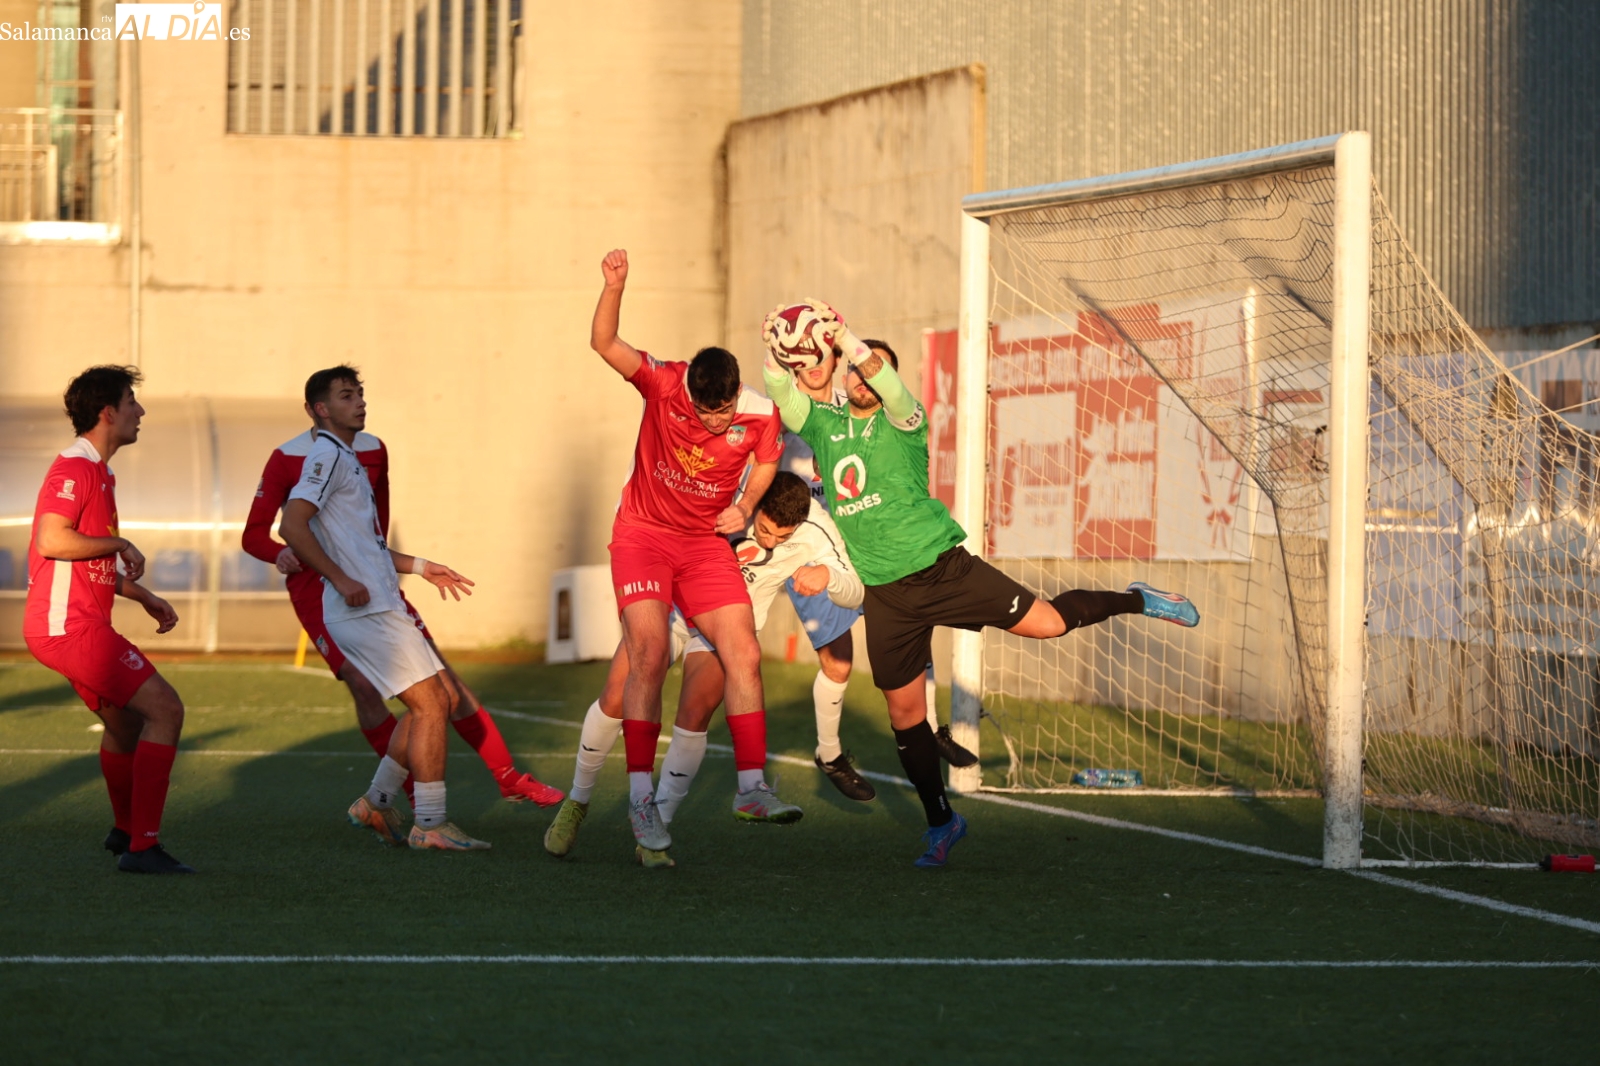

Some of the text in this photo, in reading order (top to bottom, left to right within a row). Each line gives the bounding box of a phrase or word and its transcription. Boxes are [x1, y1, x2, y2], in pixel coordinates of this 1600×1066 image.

[657, 460, 681, 481] CAJA
[664, 478, 716, 499] SALAMANCA
[623, 579, 661, 597] MILAR
